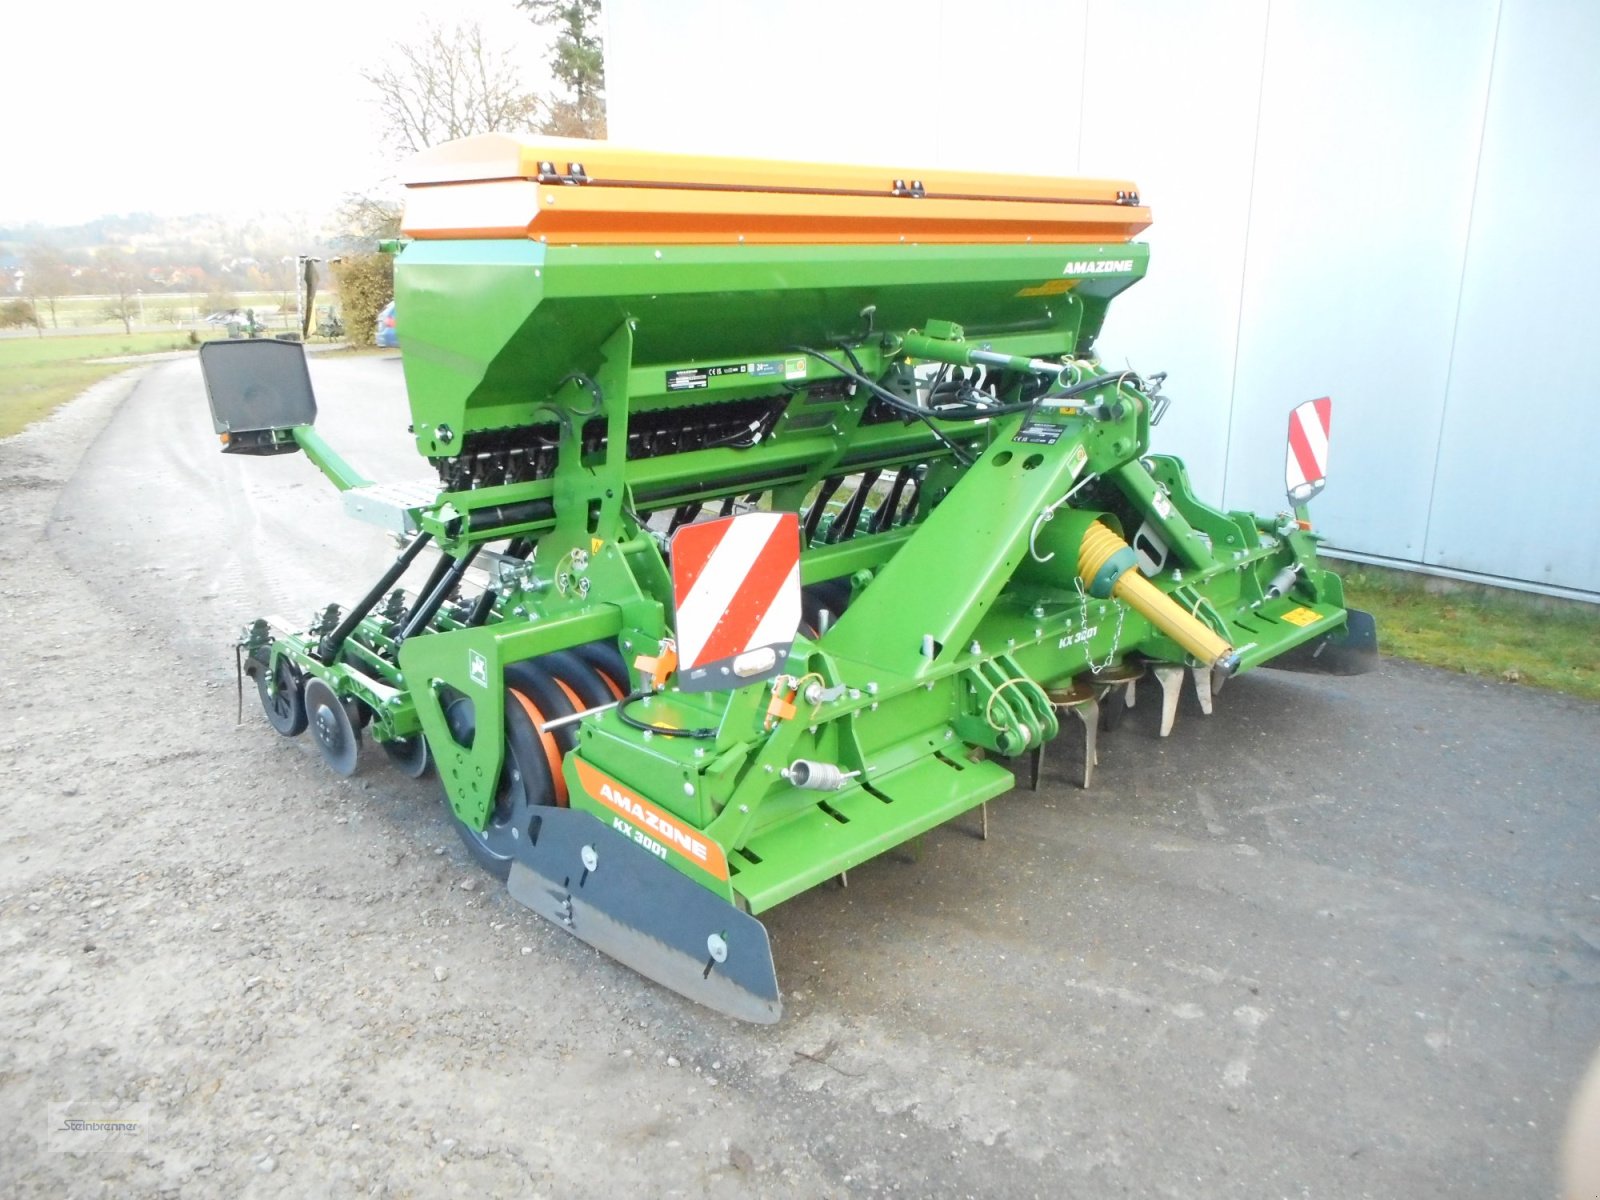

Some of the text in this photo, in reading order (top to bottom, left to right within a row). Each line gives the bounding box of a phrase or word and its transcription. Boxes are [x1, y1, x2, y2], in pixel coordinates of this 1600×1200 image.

[1063, 260, 1133, 274] AMAZONE
[1059, 635, 1073, 648] KX
[600, 784, 707, 861] AMAZONE
[613, 817, 667, 860] KX 3001
